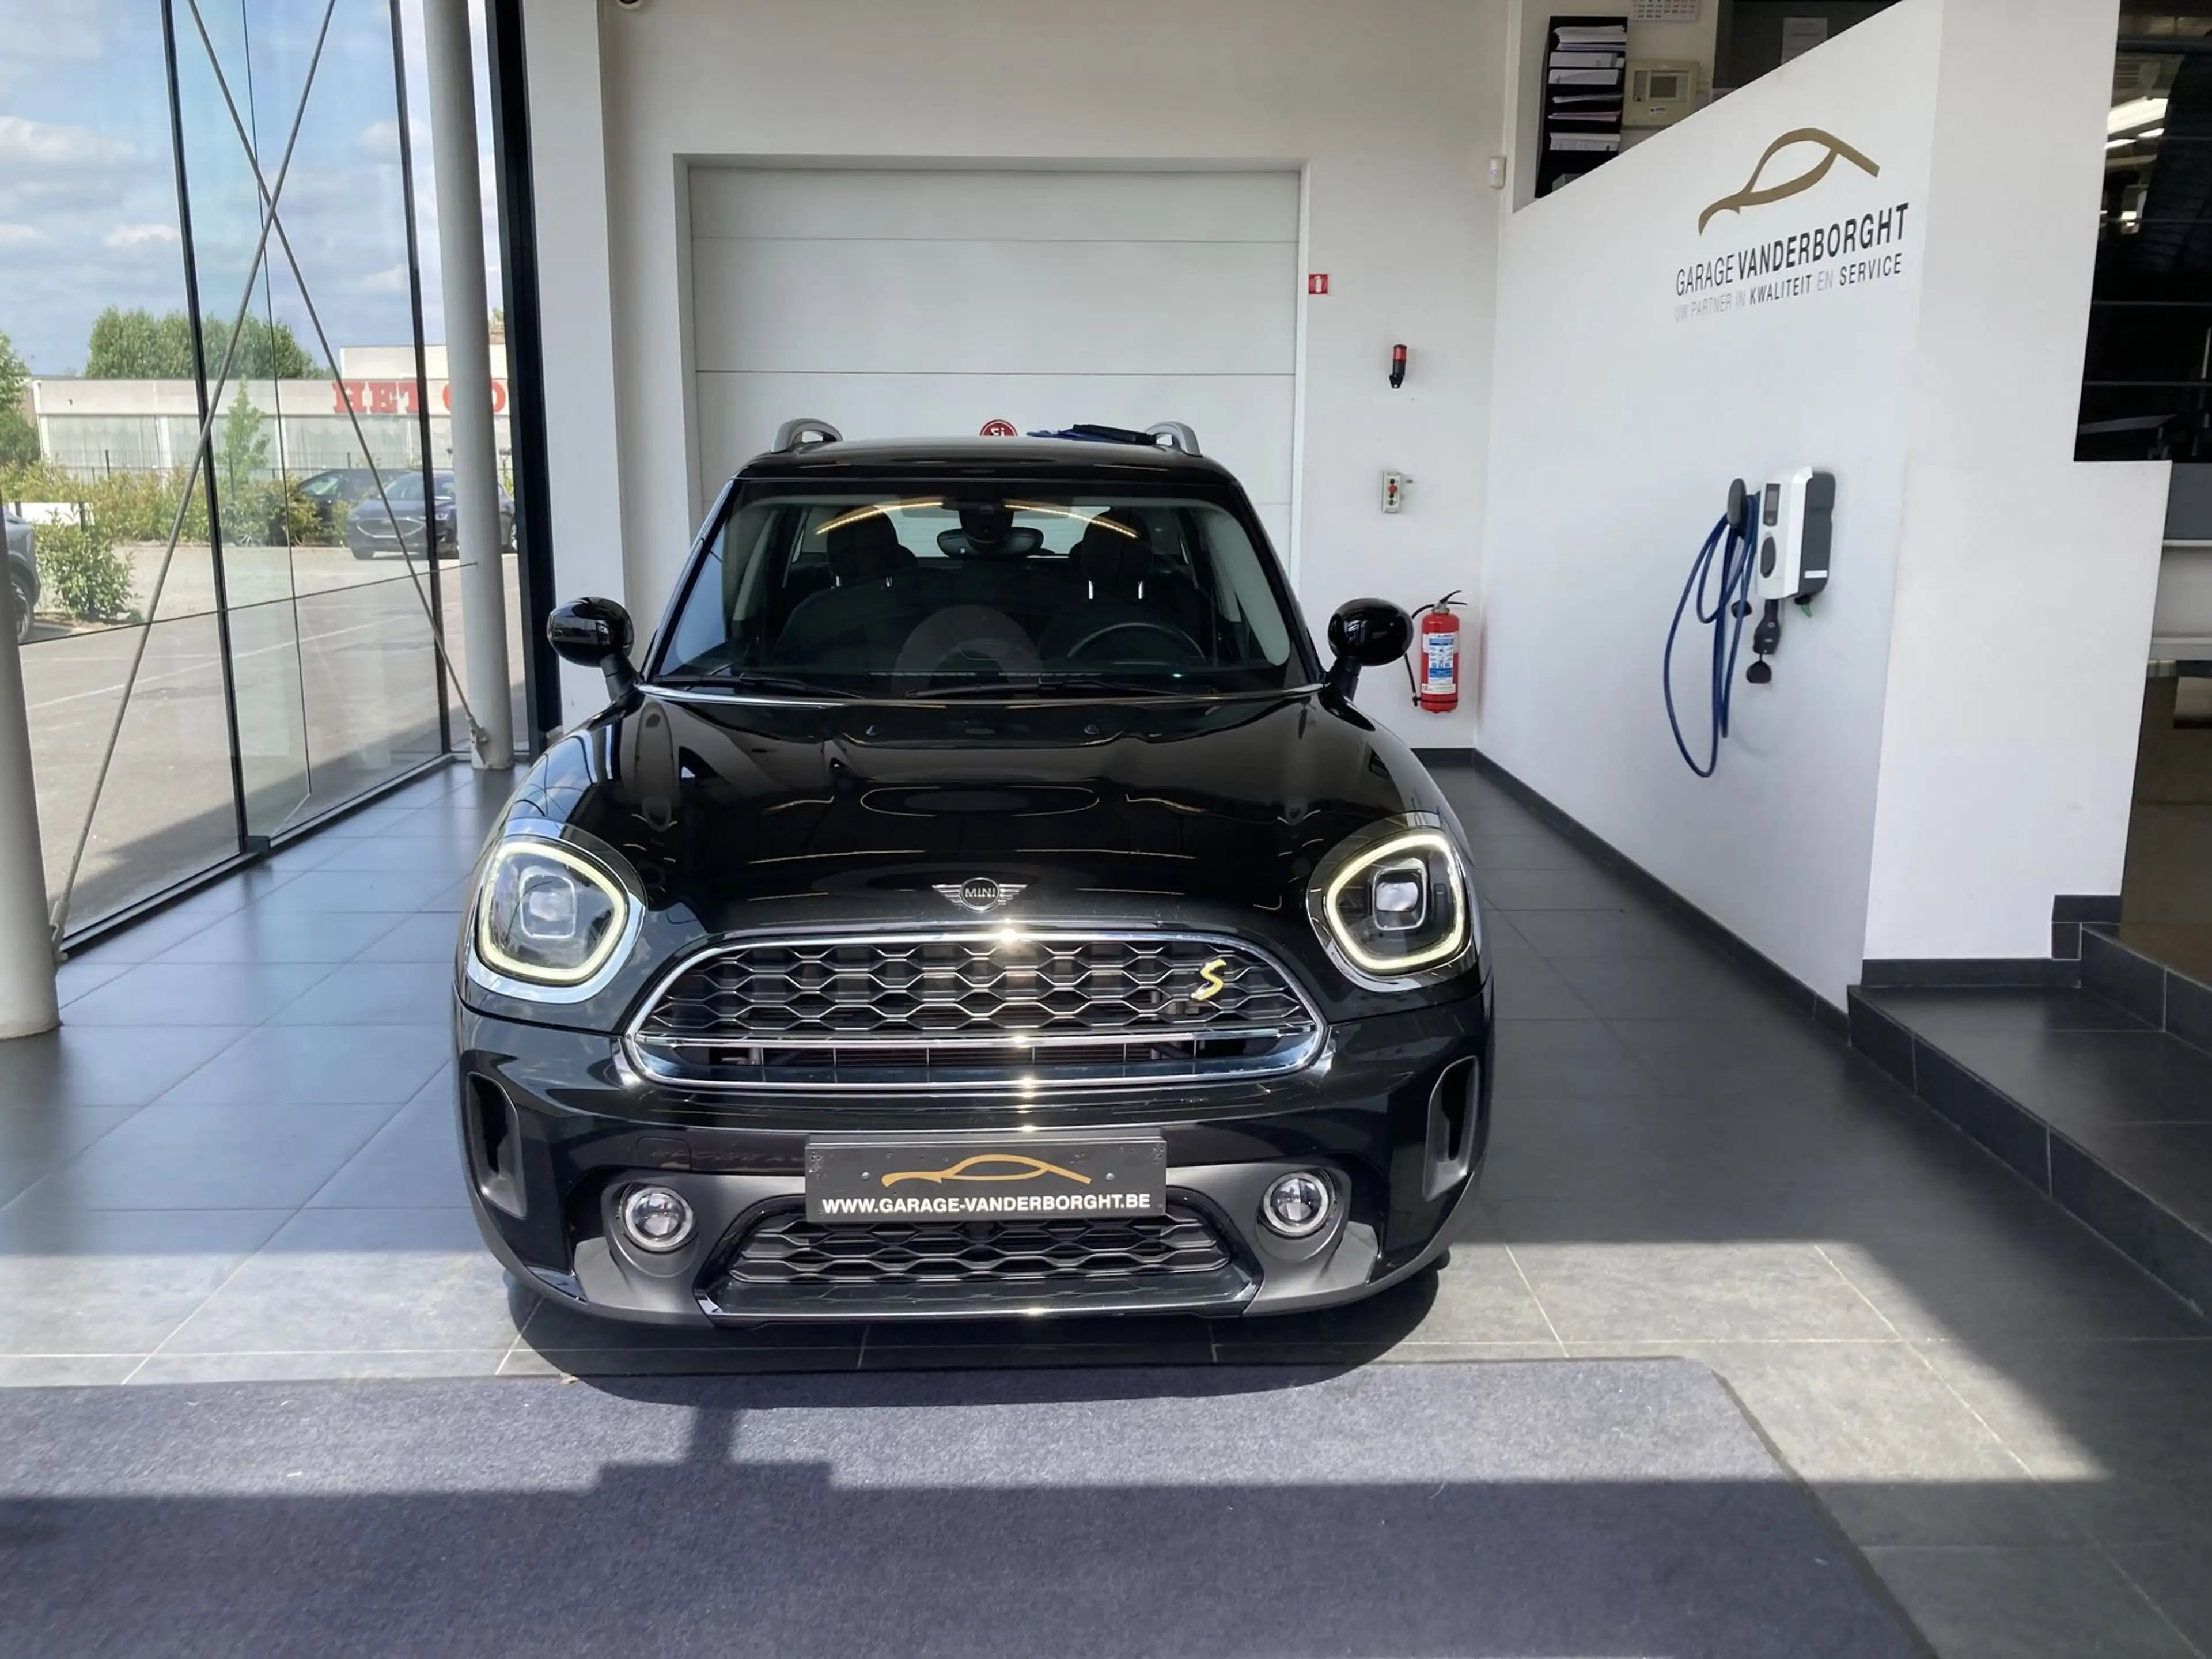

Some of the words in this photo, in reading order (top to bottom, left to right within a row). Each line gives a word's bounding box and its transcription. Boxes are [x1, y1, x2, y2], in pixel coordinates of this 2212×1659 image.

[1676, 253, 1734, 296] GARAGE
[1738, 202, 1908, 279] VANDERBORGHT
[1691, 293, 1732, 316] PARTNER
[1735, 290, 1745, 308] IN
[1749, 274, 1813, 305] KWALITEIT
[1817, 270, 1834, 291] EN
[1839, 253, 1903, 286] SERVICE
[965, 888, 995, 897] MINI
[1190, 959, 1226, 1001] S
[823, 1194, 1150, 1213] WWW.GARAGE-VANDERBORGHT.BE
